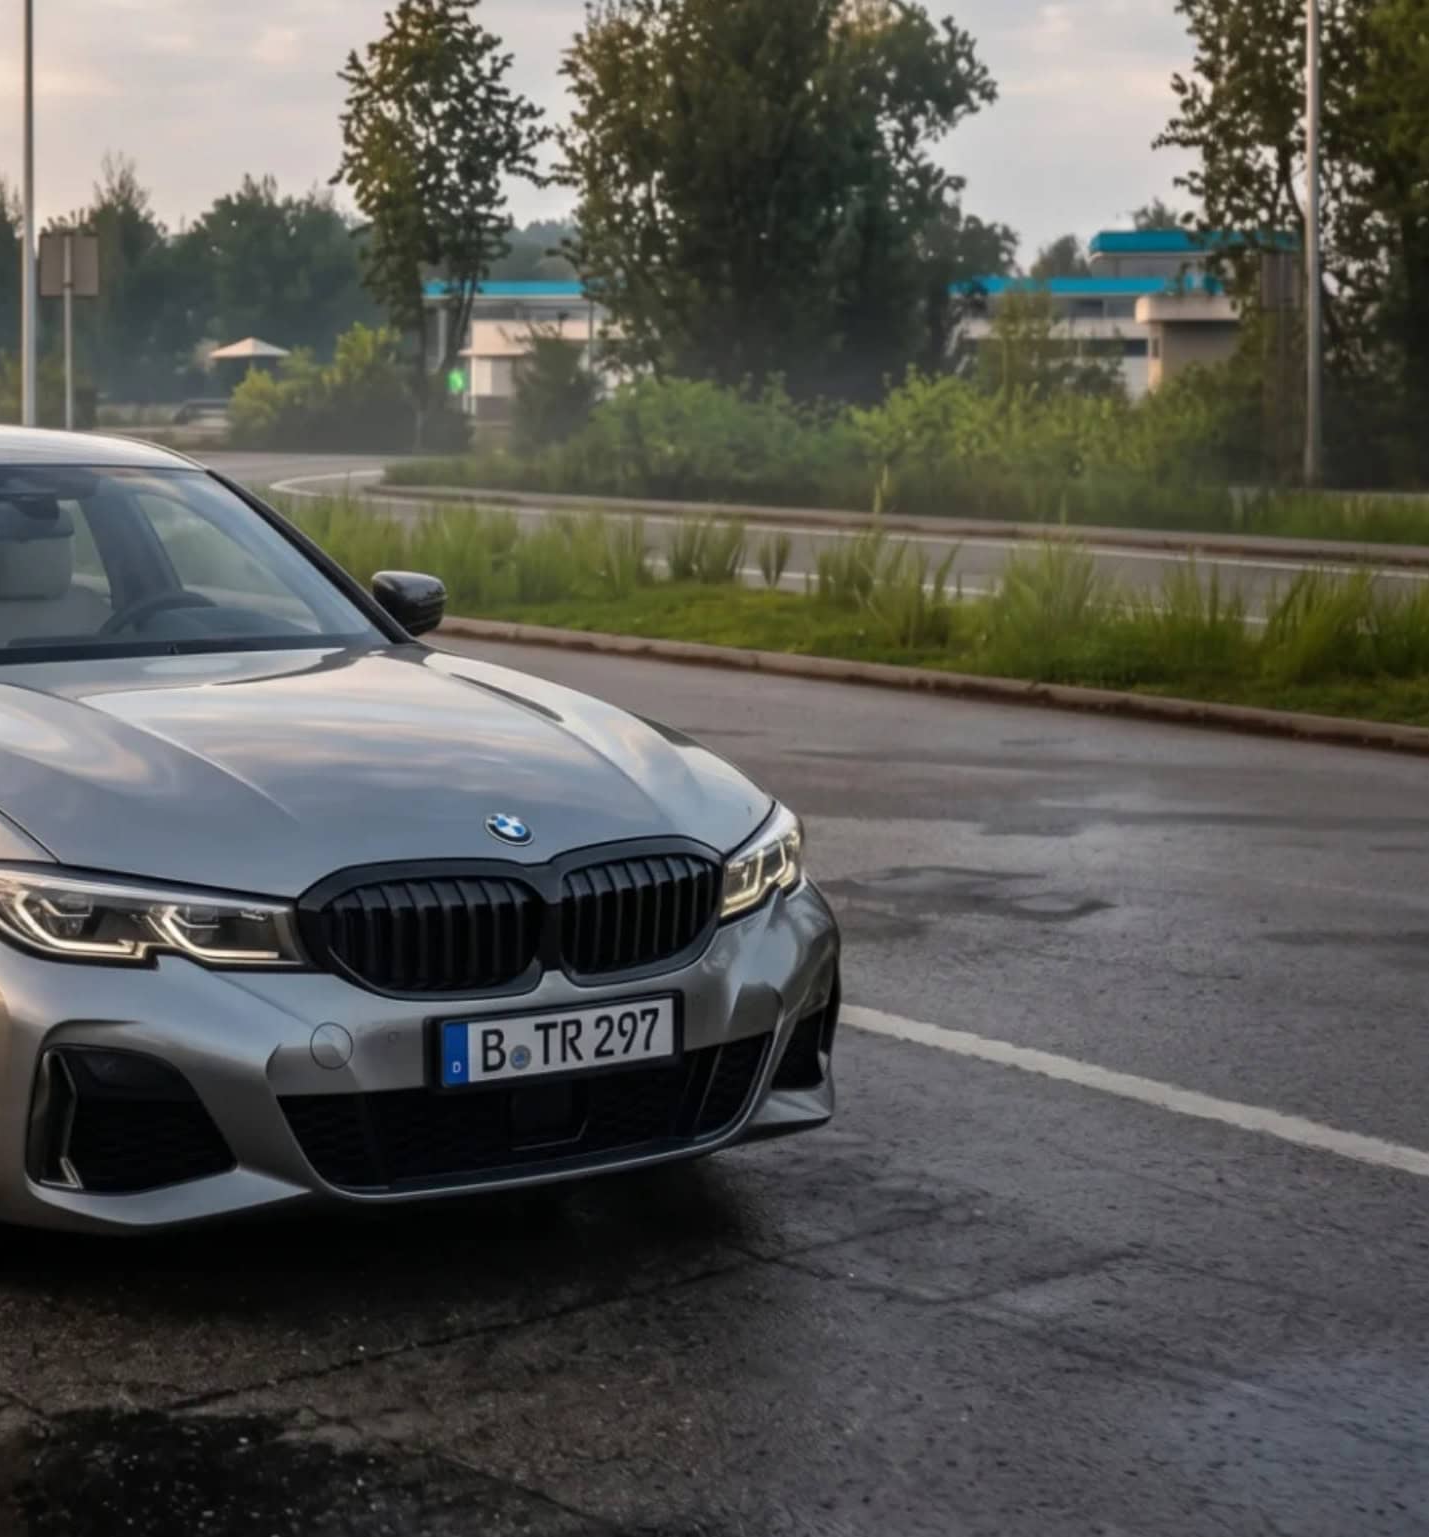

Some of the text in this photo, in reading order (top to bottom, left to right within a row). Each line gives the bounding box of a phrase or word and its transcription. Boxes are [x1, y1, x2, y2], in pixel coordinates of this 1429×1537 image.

[482, 1007, 660, 1073] B TR 297
[452, 1061, 461, 1073] D
